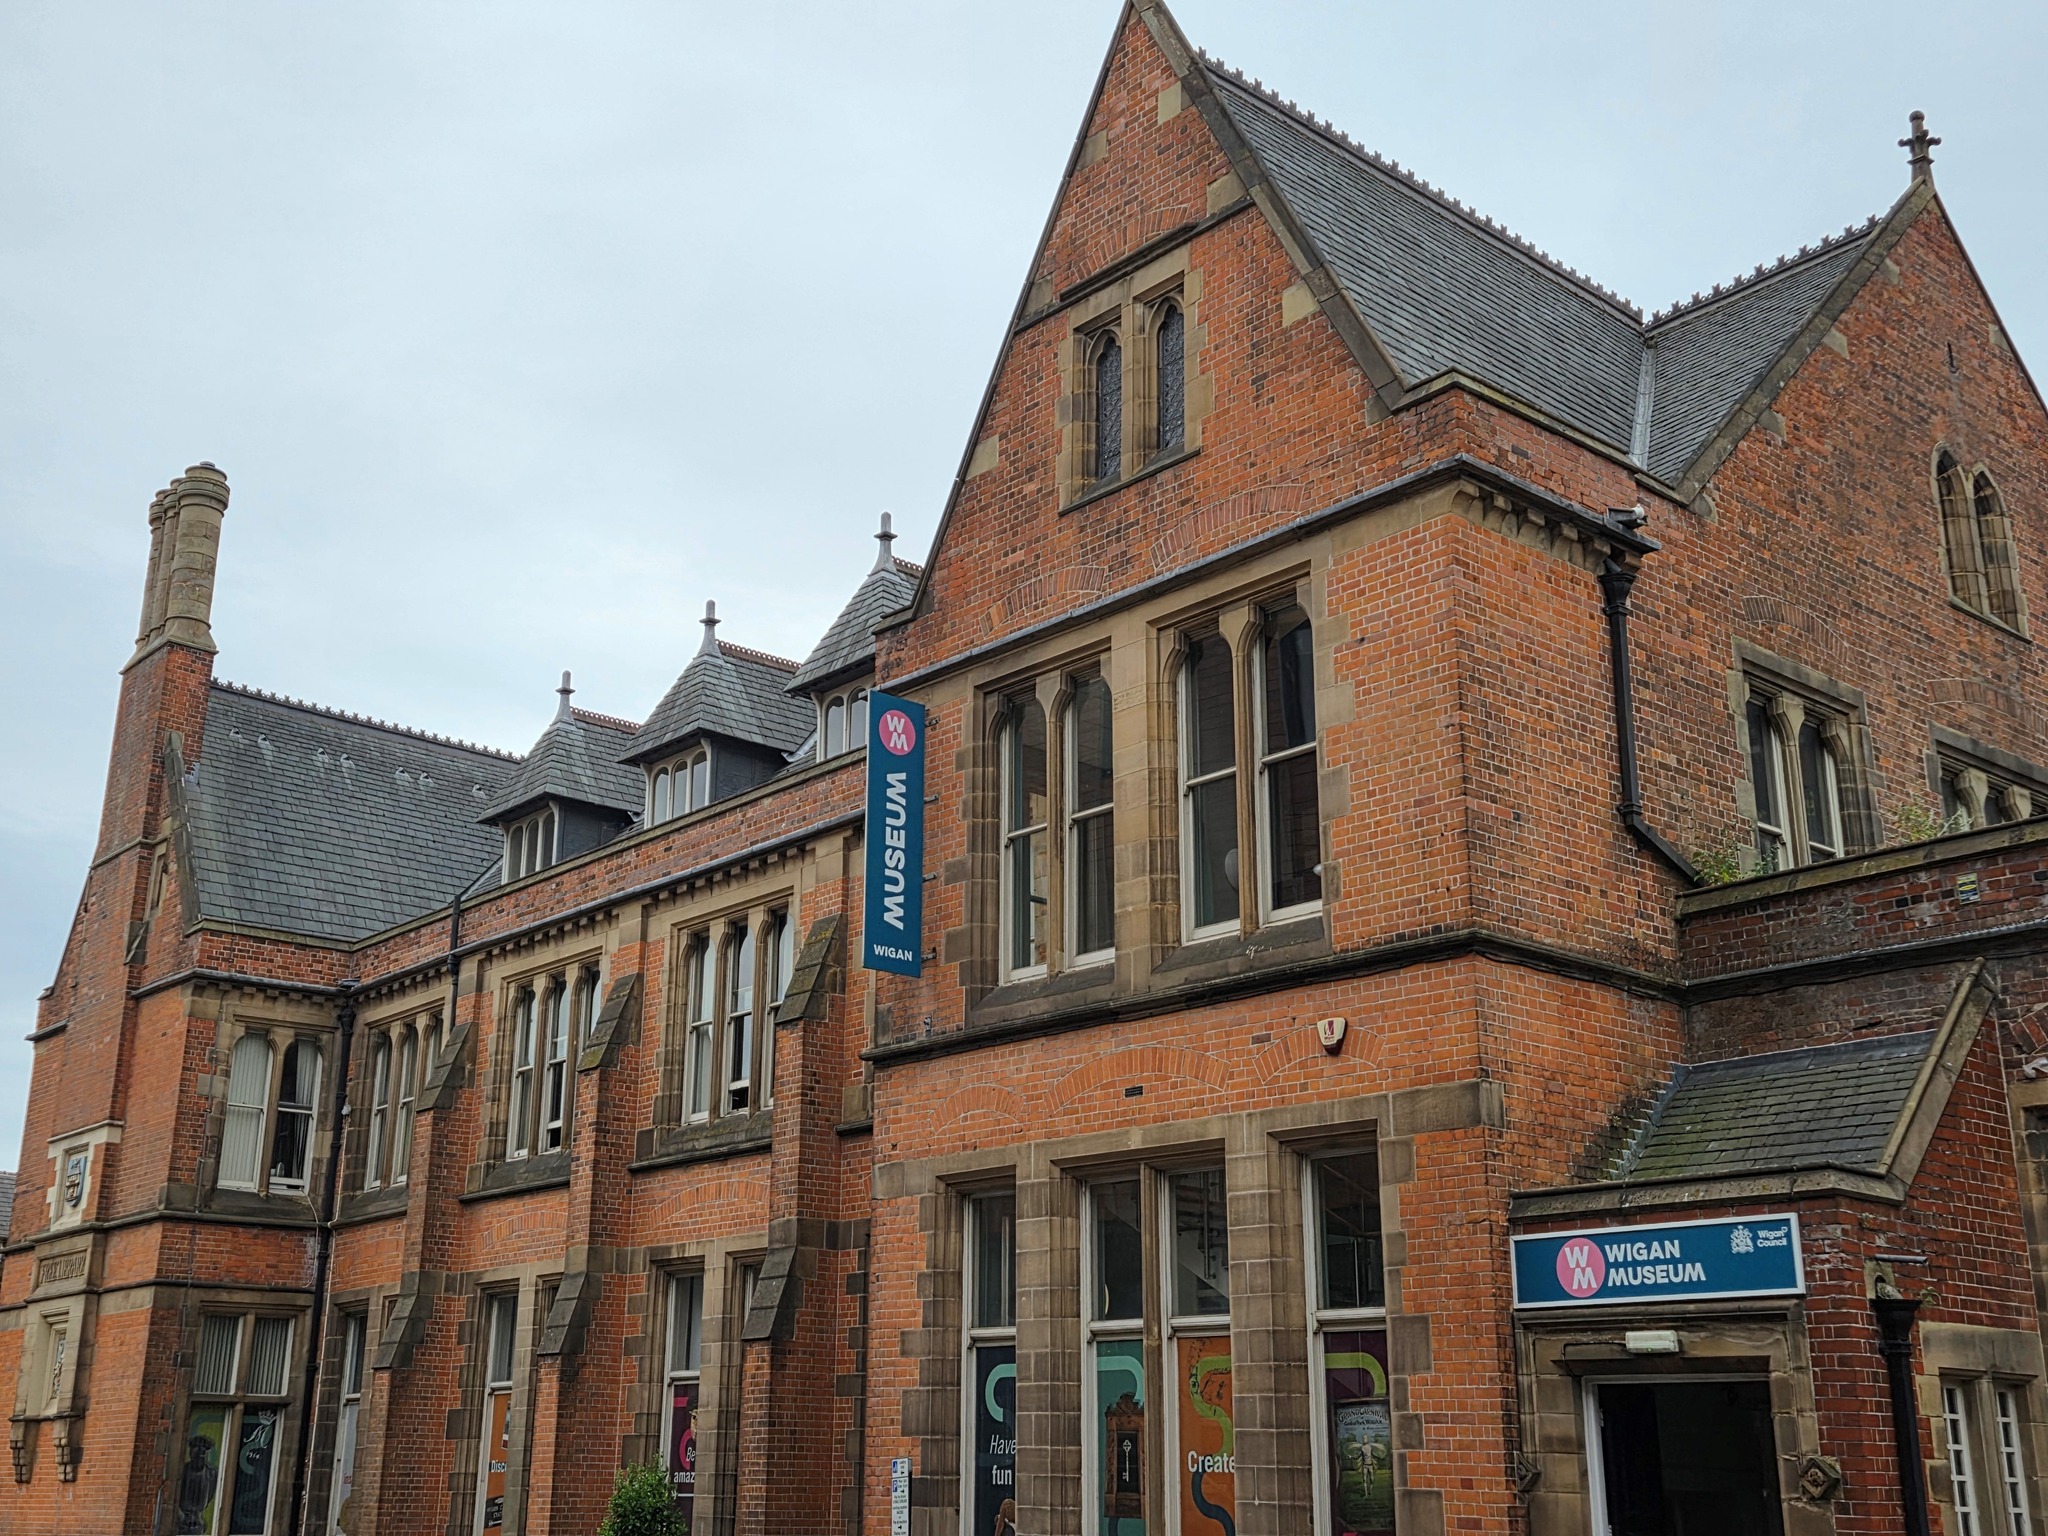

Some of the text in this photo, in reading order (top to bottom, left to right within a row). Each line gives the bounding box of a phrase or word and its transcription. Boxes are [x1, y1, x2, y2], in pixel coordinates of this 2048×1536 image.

[883, 772, 907, 930] MUSEUM
[873, 944, 913, 962] WIGAN
[1757, 1229, 1785, 1240] Wigan
[1757, 1237, 1787, 1248] Council
[1604, 1240, 1681, 1262] WIGAN
[1607, 1262, 1706, 1287] MUSEUM
[989, 1434, 1016, 1454] Have
[1187, 1450, 1235, 1473] Create
[992, 1465, 1012, 1485] fun
